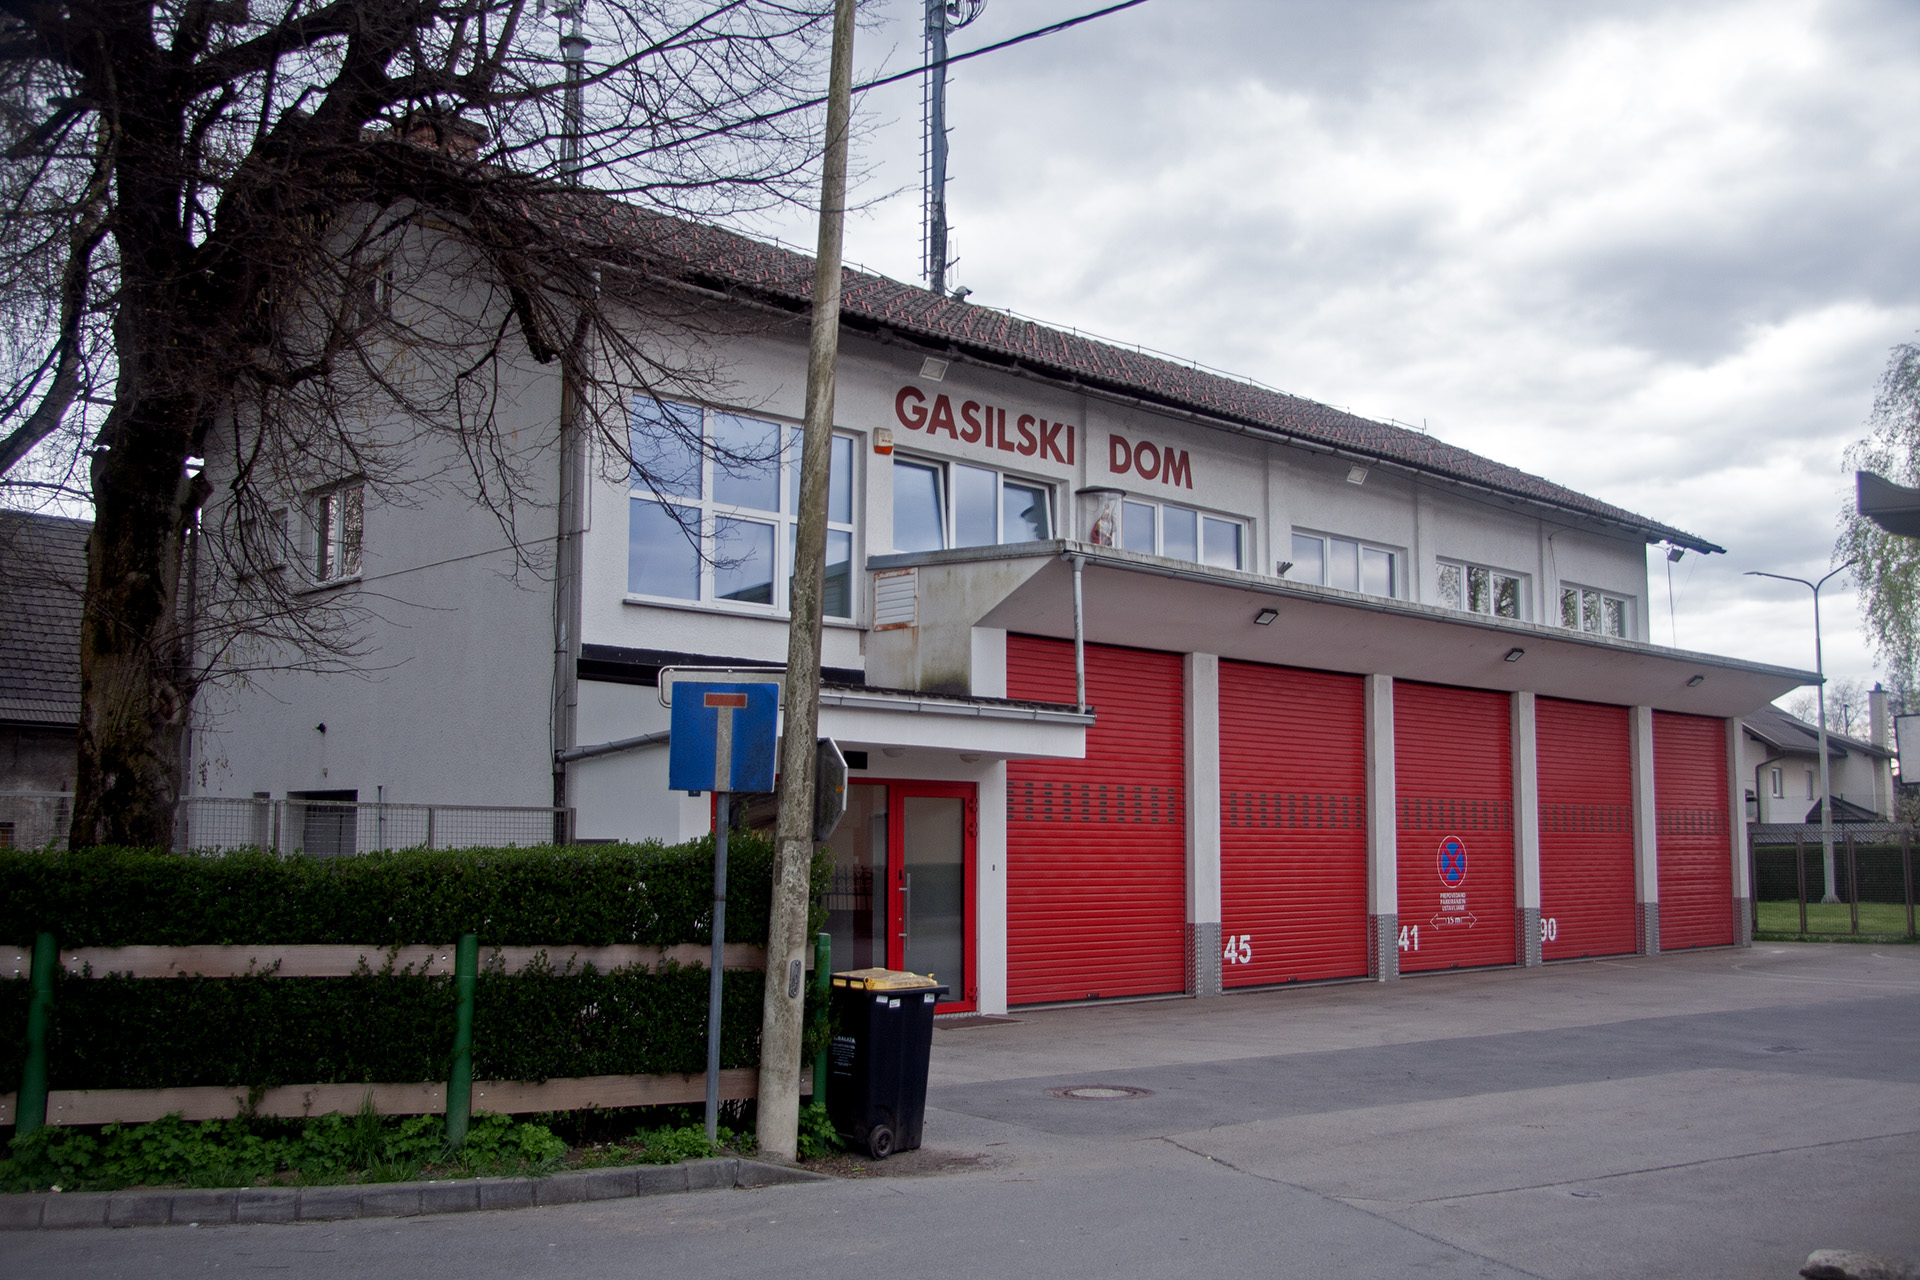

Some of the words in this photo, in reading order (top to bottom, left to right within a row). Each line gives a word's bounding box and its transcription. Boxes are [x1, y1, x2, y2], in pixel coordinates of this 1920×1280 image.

[895, 385, 1075, 466] GASILSKI
[1109, 433, 1193, 490] DOM
[1398, 924, 1419, 952] 41
[1540, 917, 1557, 942] 90
[1223, 934, 1252, 965] 45
